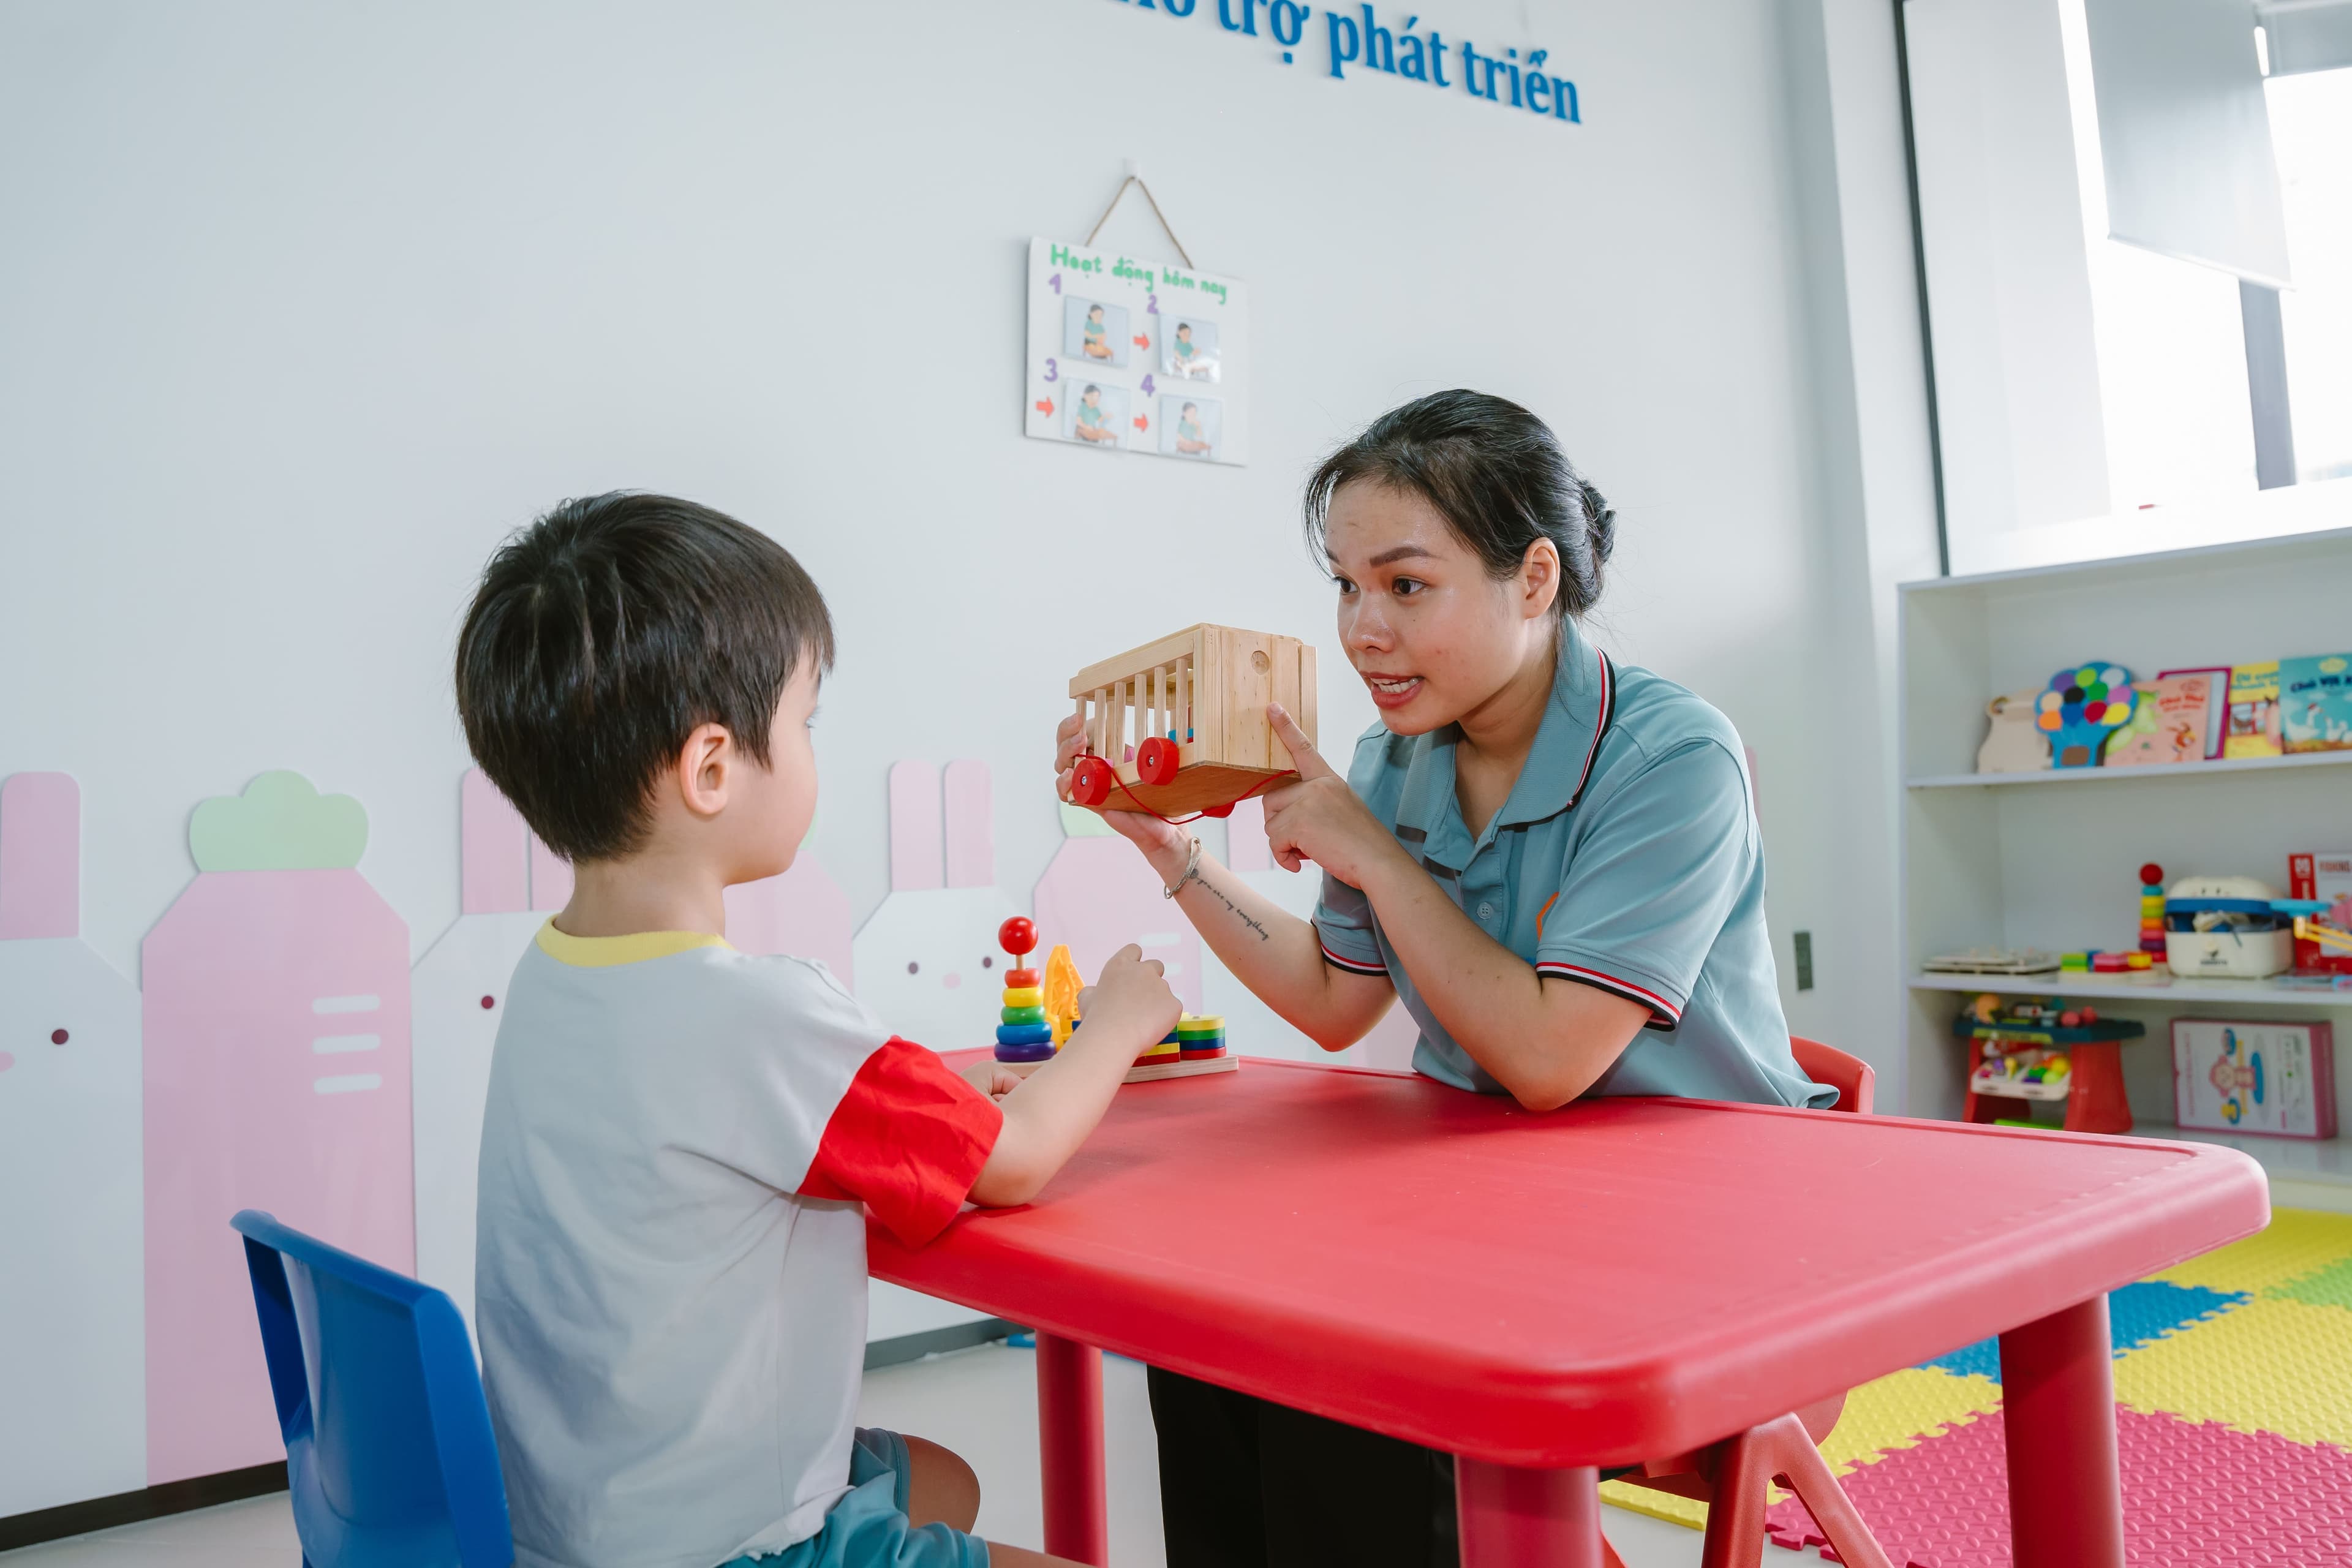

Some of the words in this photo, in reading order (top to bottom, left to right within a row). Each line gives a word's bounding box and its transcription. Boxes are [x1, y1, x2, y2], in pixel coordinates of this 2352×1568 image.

[1325, 4, 1451, 88] phát
[1461, 41, 1581, 124] triển
[1049, 274, 1061, 295] 1
[1050, 243, 1102, 279] Hoạt
[1111, 256, 1155, 293] động
[1163, 266, 1195, 288] hôm
[1200, 280, 1227, 305] nay
[1147, 294, 1159, 314] 2
[1044, 358, 1058, 382] 3
[1140, 374, 1155, 396] 4
[1226, 900, 1234, 911] my
[1236, 909, 1269, 941] everything
